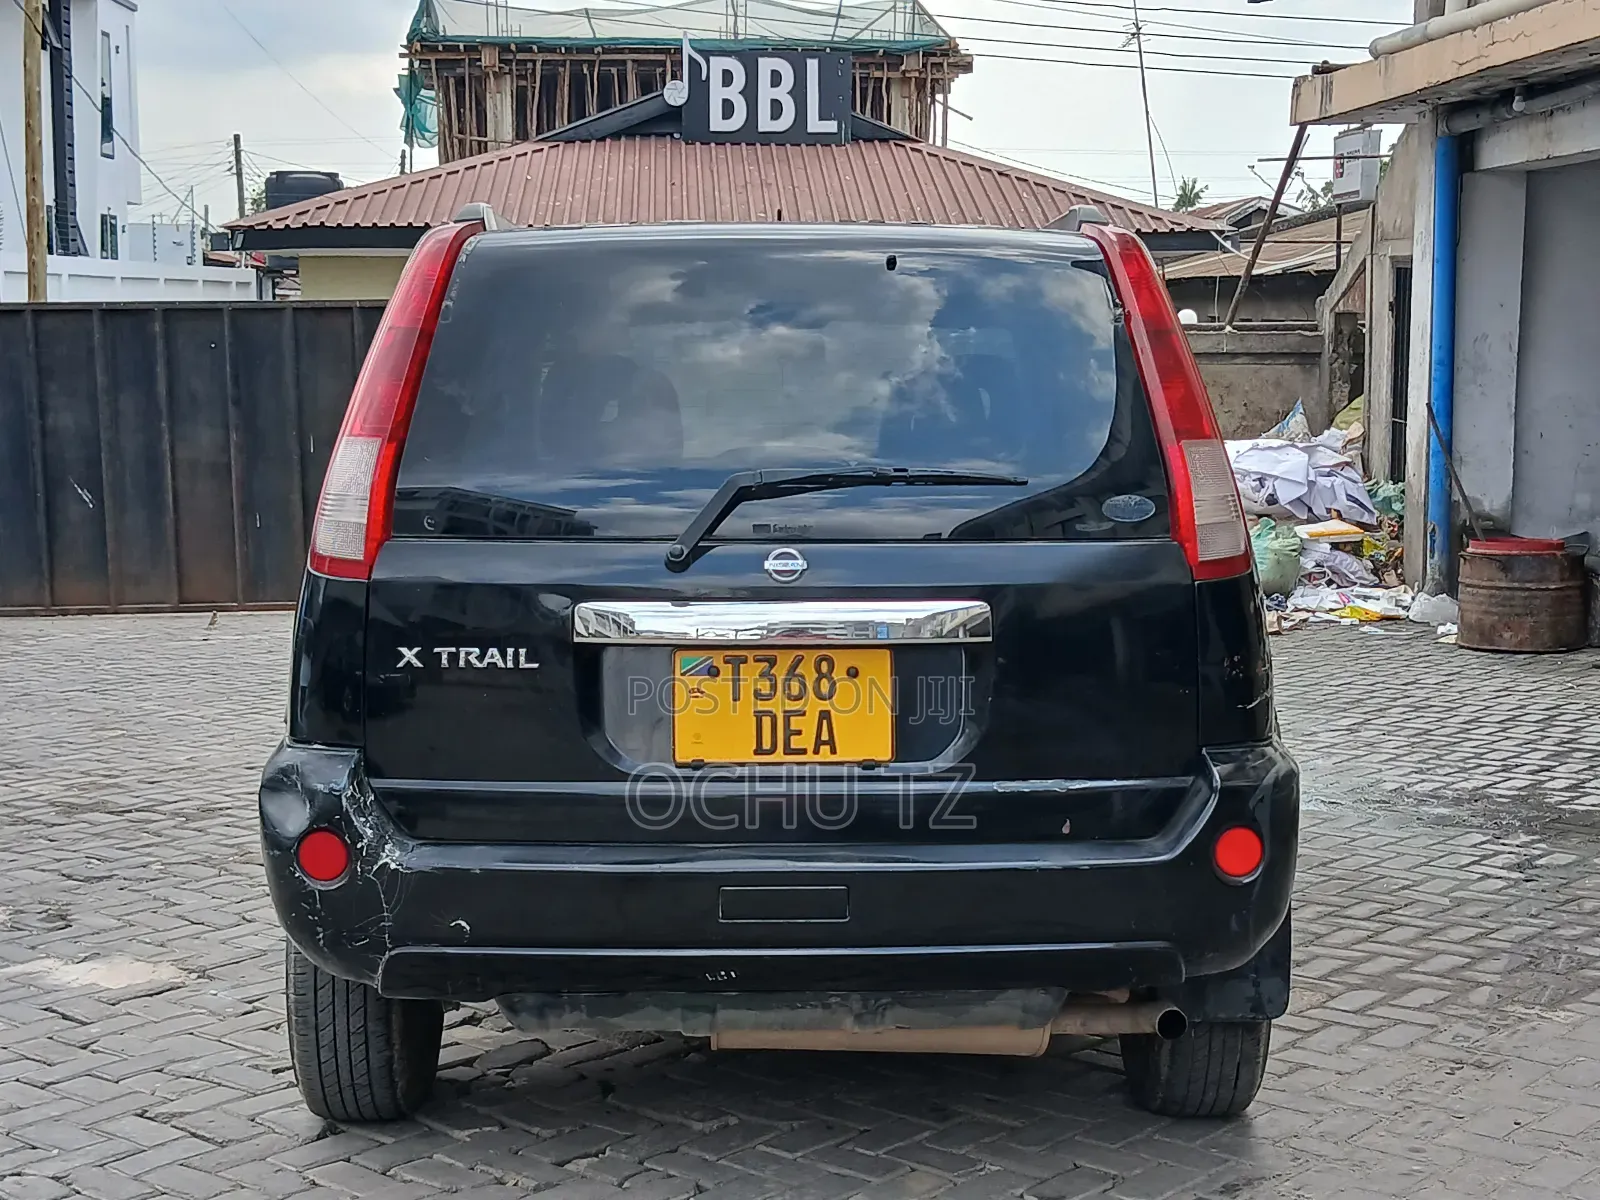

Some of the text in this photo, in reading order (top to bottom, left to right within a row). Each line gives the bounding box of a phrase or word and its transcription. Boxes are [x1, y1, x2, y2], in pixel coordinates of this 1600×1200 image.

[709, 56, 838, 133] BBL
[396, 647, 540, 668] X TRAIL
[723, 655, 837, 701] T368
[753, 709, 837, 755] DEA
